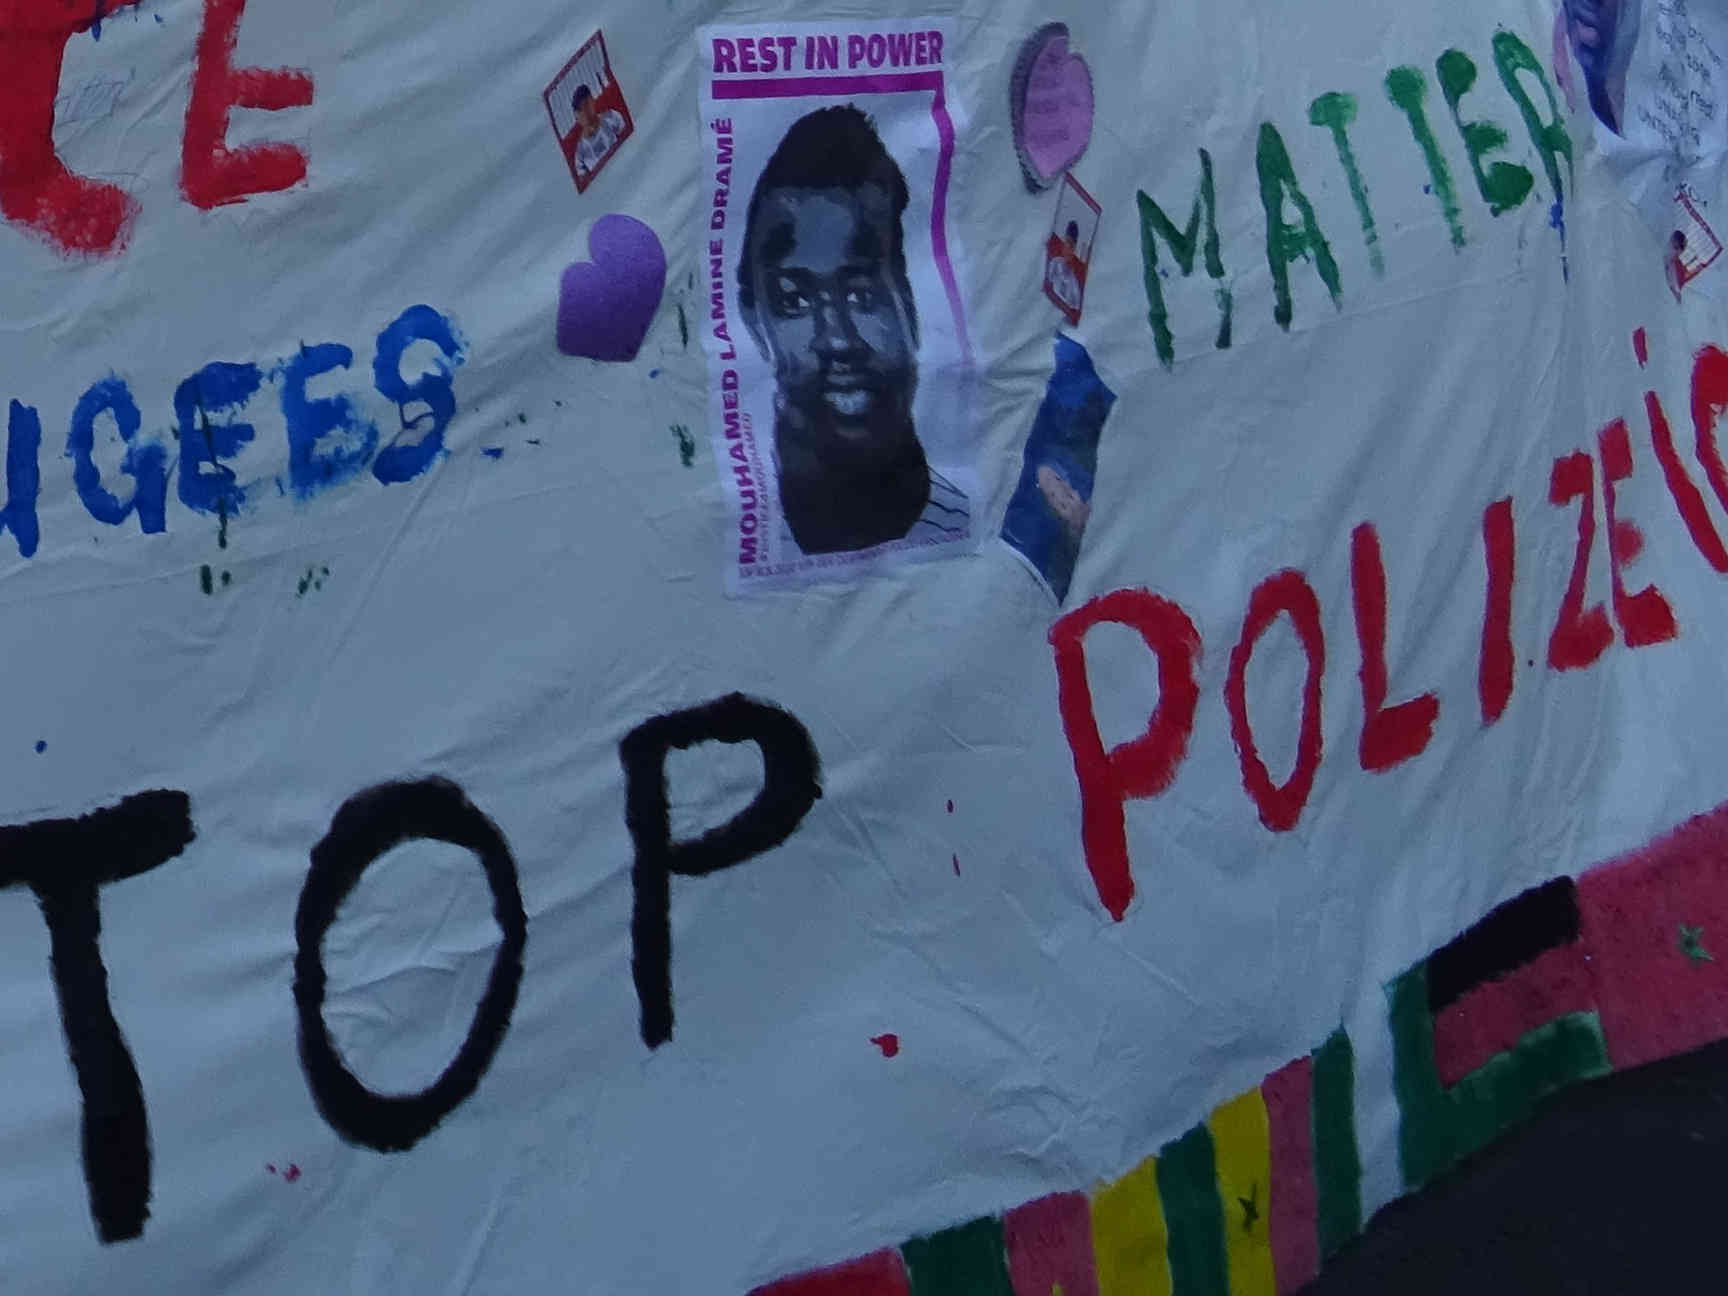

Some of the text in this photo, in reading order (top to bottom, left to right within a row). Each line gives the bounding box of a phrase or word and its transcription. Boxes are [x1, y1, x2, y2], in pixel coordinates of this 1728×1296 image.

[712, 30, 944, 73] REST IN POWER
[710, 117, 734, 231] DRAMÉ
[1135, 27, 1574, 368] MATTER
[709, 238, 737, 361] LAMINE
[722, 368, 759, 564] MOUHAMED
